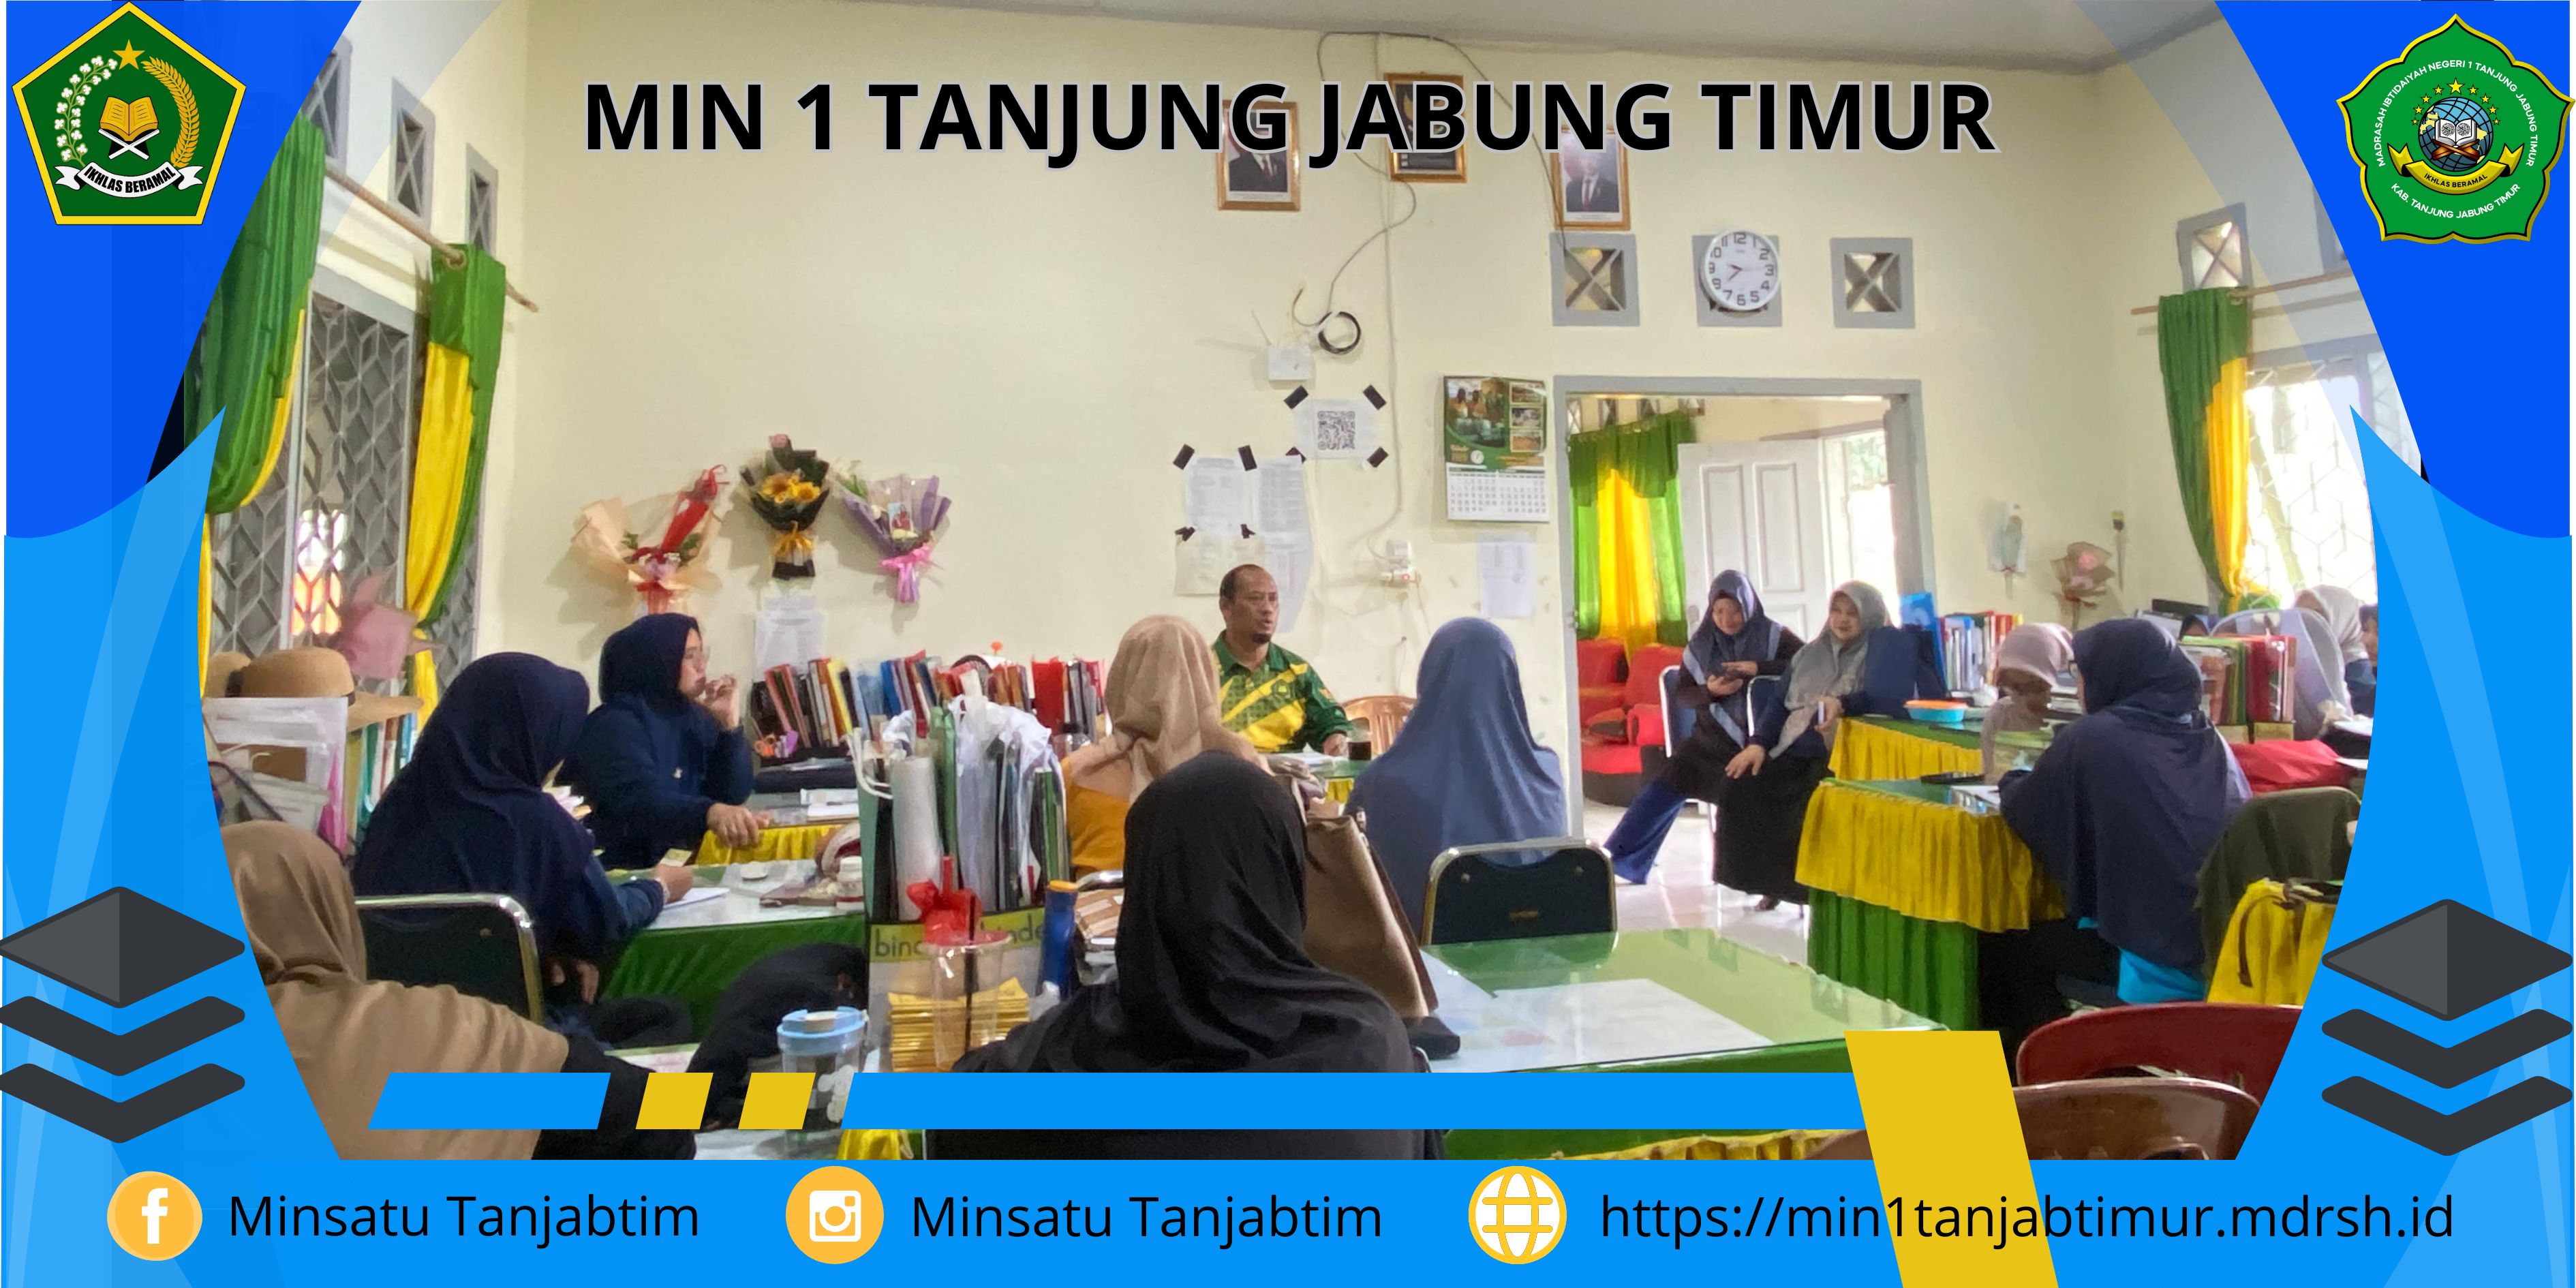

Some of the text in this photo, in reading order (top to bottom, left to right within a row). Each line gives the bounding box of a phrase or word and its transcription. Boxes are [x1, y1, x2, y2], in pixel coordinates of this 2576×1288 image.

[1733, 232, 1747, 244] 12
[1759, 248, 1770, 260] 2
[1764, 264, 1774, 276] 3
[1760, 280, 1770, 290] 4
[1723, 289, 1733, 301] 7
[1736, 294, 1746, 306] 6
[1749, 290, 1760, 303] 5
